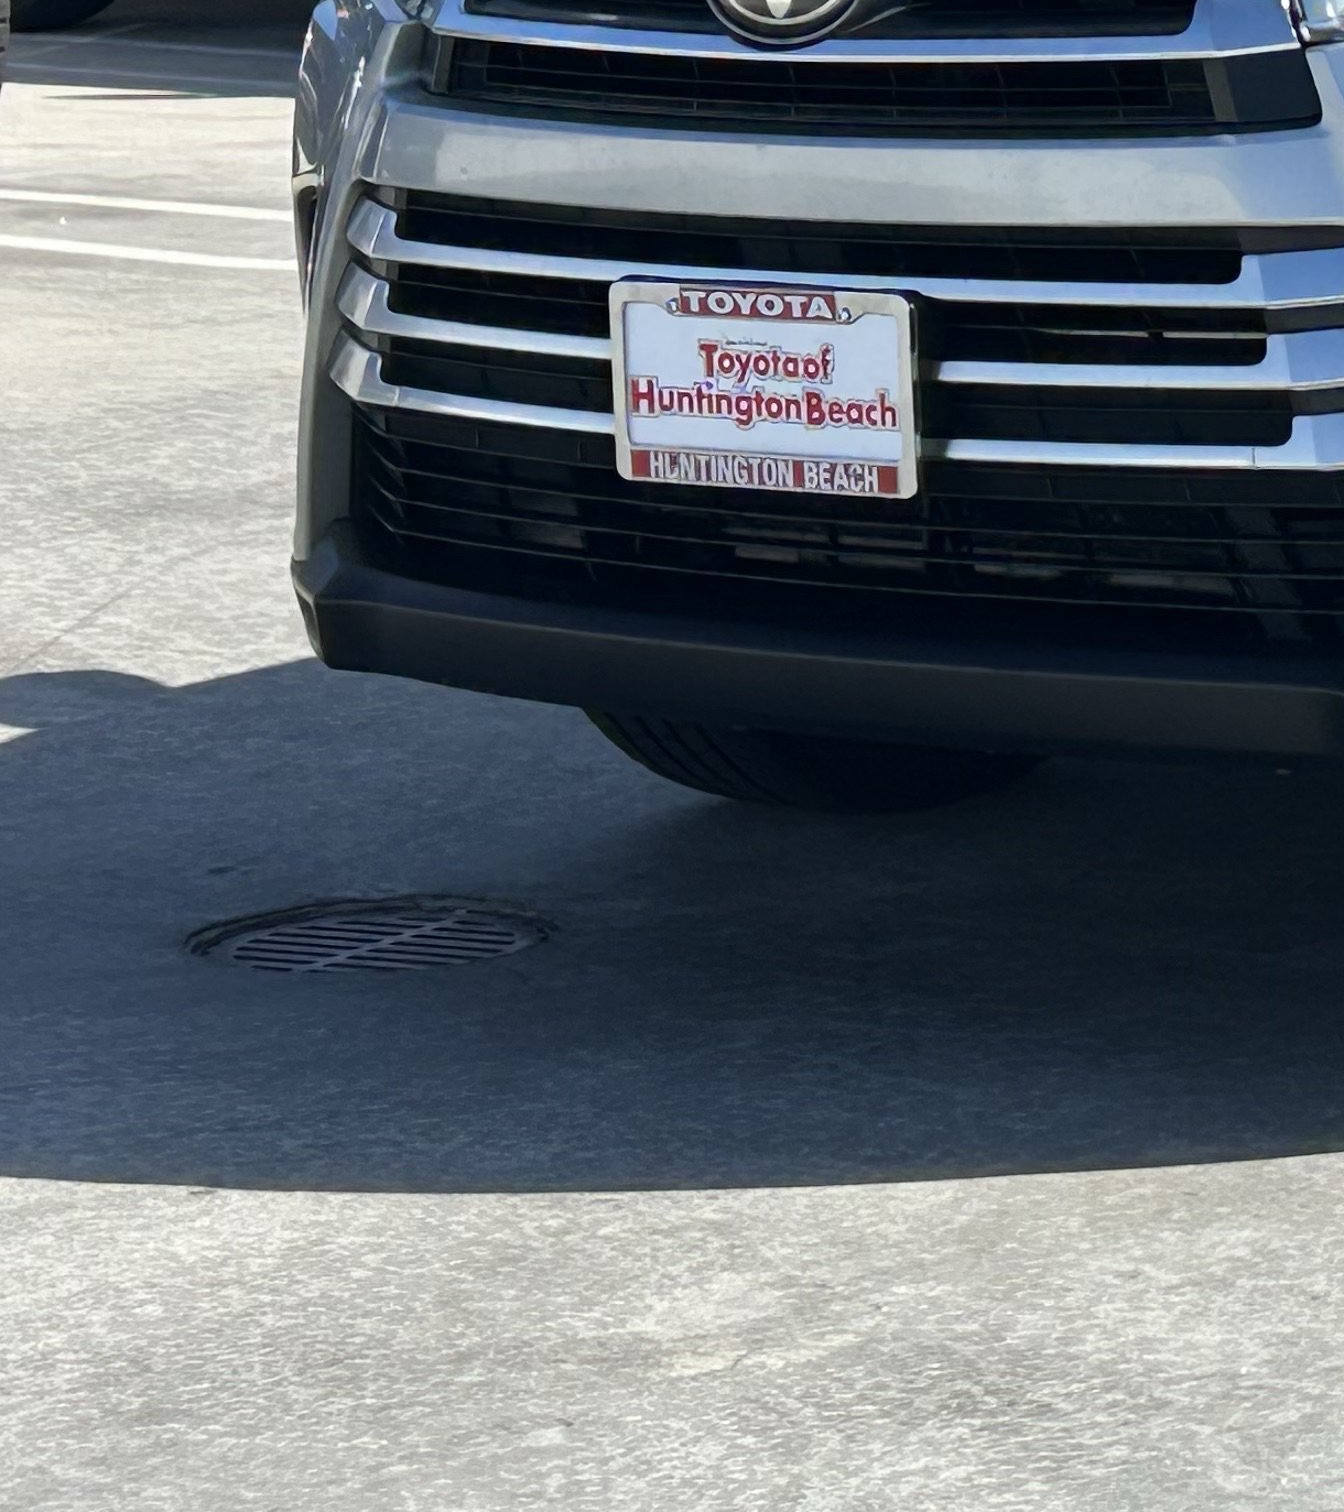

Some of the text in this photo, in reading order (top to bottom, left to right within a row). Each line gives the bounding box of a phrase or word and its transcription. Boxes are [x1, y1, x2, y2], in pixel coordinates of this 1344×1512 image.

[681, 290, 834, 320] TOYOTA
[805, 390, 897, 429] Beach
[803, 460, 879, 494] BEACH
